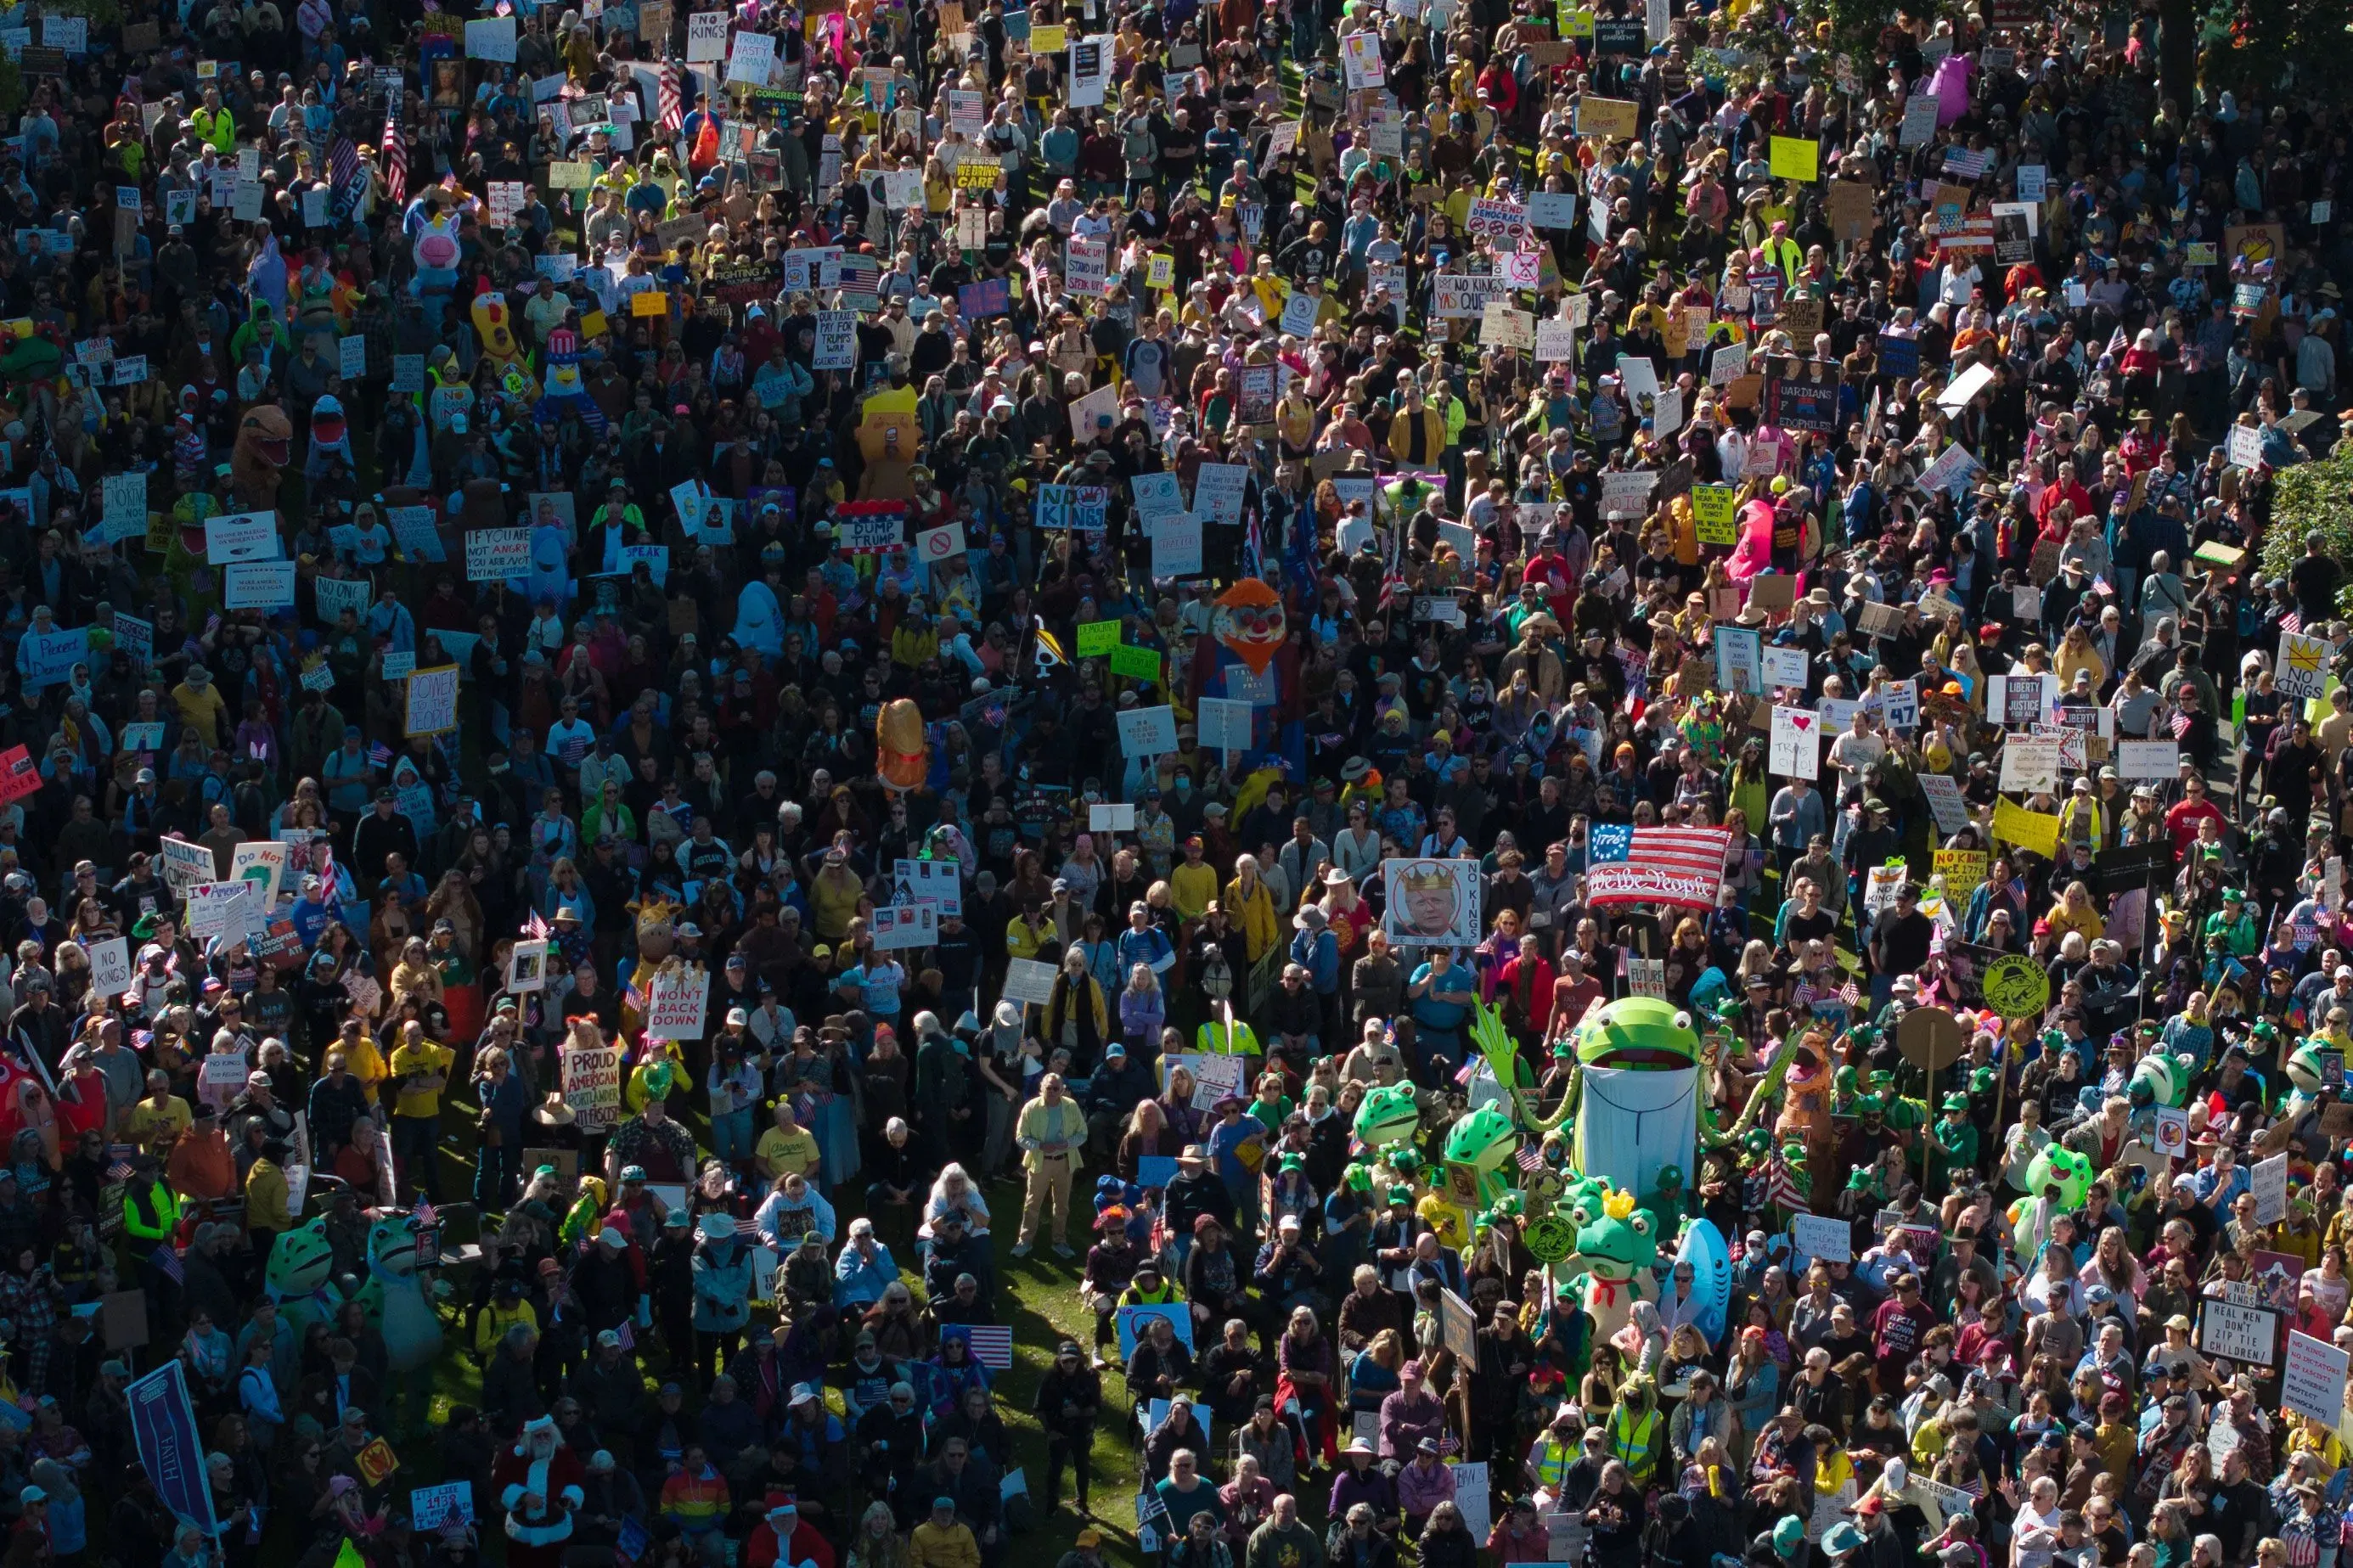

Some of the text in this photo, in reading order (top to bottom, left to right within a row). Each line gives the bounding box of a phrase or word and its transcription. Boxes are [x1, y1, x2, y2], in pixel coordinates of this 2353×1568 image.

[699, 15, 717, 25] NO
[691, 25, 725, 39] KINGS
[740, 34, 770, 47] PROUD
[735, 45, 768, 56] NASTY
[755, 89, 803, 101] CONGRESS
[959, 164, 999, 176] WE BRING
[957, 177, 994, 188] CARE
[121, 198, 138, 206] NOT
[1478, 200, 1523, 214] DEFEND
[1472, 209, 1525, 224] DEMOCRACY
[2245, 229, 2267, 239] NO
[1069, 245, 1106, 257] WAKE UP!
[1069, 259, 1104, 274] STAND UP!
[715, 267, 771, 281] FIGHTING A
[1068, 278, 1104, 292] SPEAK UP!
[1455, 277, 1504, 292] NO KINGS
[1437, 292, 1457, 309] YAS
[1787, 302, 1814, 312] STOP
[819, 311, 857, 322] OUR TAXES
[819, 322, 853, 334] PAY FOR
[821, 333, 852, 345] TRUMPS
[827, 344, 845, 353] WAR
[1538, 347, 1570, 358] THINK
[842, 355, 853, 364] US
[1042, 488, 1074, 504] NO
[1604, 498, 1620, 512] NO
[1042, 503, 1104, 526] KINGS
[853, 521, 894, 535] DUMP
[468, 529, 531, 545] IF YOU ARE
[851, 533, 896, 547] TRUMP
[469, 543, 529, 557] NOT ANGRY
[626, 547, 660, 557] SPEAK
[468, 555, 531, 567] YOU ARE NOT
[468, 567, 501, 578] PAYING
[318, 578, 334, 594] NO
[115, 617, 150, 642] FASCISM
[1728, 642, 1749, 650] KINGS
[2288, 667, 2313, 684] NO
[410, 672, 457, 699] POWER
[2008, 681, 2041, 693] LIBERTY
[2274, 677, 2324, 700] KINGS
[2008, 700, 2040, 711] JUSTICE
[1889, 705, 1916, 724] 47
[2064, 714, 2097, 723] LIBERTY
[1938, 778, 1952, 787] OUR
[1596, 833, 1623, 846] 1776
[164, 840, 209, 868] SILENCE
[1937, 852, 1987, 865] NO KINGS
[1934, 864, 1984, 875] SINCE 1776
[1590, 868, 1712, 900] We People
[1877, 885, 1891, 894] NO
[189, 886, 199, 900] I
[1469, 863, 1478, 939] NO KINGS
[262, 931, 299, 948] TROOPERS
[259, 942, 303, 958] POLICE ATF
[101, 951, 116, 967] NO
[1991, 954, 2046, 982] PORTLAND
[97, 965, 127, 987] KINGS
[656, 987, 703, 1000] WON'T
[657, 1003, 700, 1014] BACK
[2005, 995, 2047, 1018] BRIGADE
[653, 1015, 697, 1026] DOWN
[571, 1052, 616, 1072] PROUD
[568, 1071, 618, 1093] AMERICAN
[567, 1089, 618, 1106] PORTLANDER
[771, 1142, 806, 1155] Oregon
[1800, 1221, 1825, 1232] Human
[2234, 1283, 2247, 1294] NO
[2226, 1292, 2255, 1307] KINGS
[2214, 1304, 2262, 1324] REAL MEN
[2225, 1319, 2251, 1334] DON'T
[2215, 1329, 2258, 1346] ZIP TIE
[2292, 1340, 2328, 1358] NO KINGS
[2291, 1351, 2341, 1376] NO DICTATORS
[2289, 1361, 2332, 1384] NO FASCISTS
[2287, 1384, 2318, 1401] PROTECT
[2300, 1378, 2331, 1395] AMERICA
[2285, 1395, 2328, 1418] DEMOCRACY
[1917, 1477, 1958, 1499] FREEDOM
